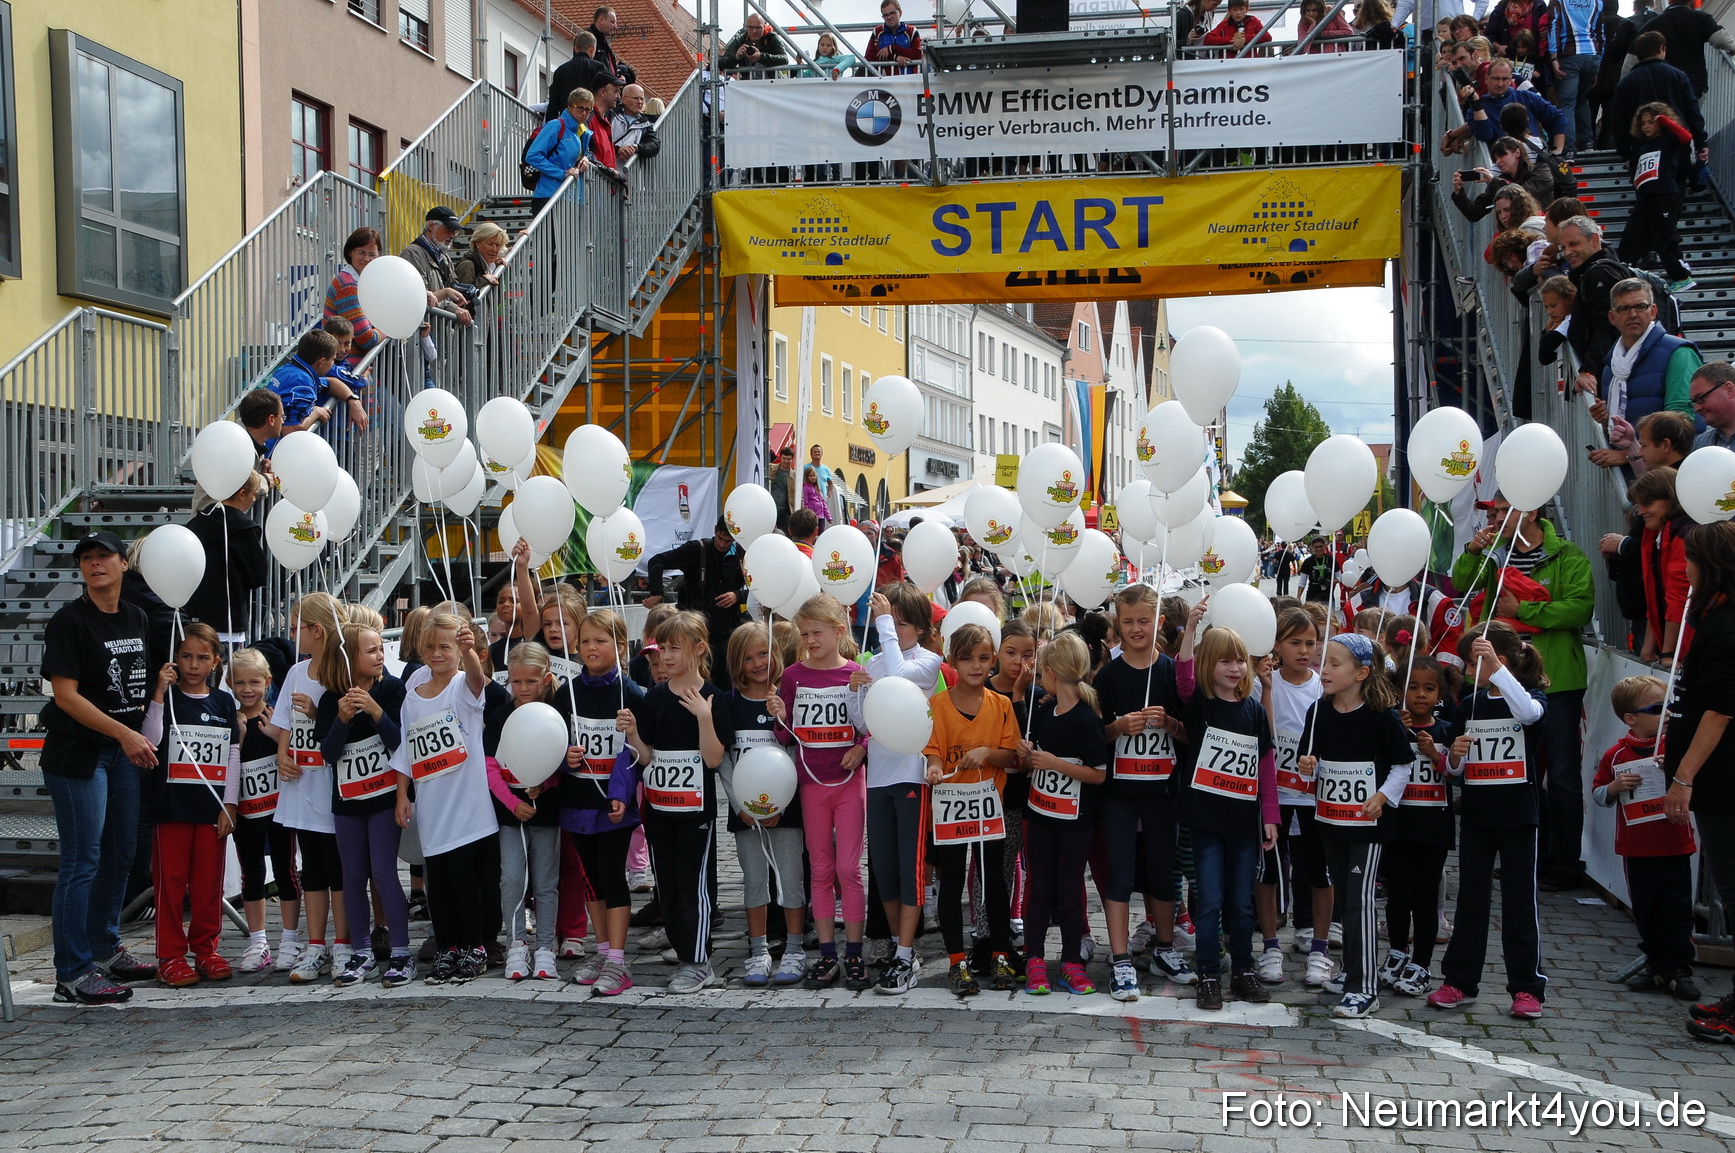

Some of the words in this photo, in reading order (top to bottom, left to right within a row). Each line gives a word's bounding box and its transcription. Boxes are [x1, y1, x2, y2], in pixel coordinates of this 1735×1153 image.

[851, 90, 898, 110] BMW
[916, 91, 993, 117] BMW
[1001, 80, 1270, 113] EfficientDynamics
[917, 117, 995, 140] Weniger
[999, 116, 1101, 136] Verbrauch.
[1106, 114, 1156, 132] Mehr
[1161, 111, 1272, 130] Fahrfreude.
[930, 195, 1165, 257] START
[1207, 220, 1291, 235] Neumarkter
[1293, 218, 1360, 232] Stadtlauf
[748, 235, 827, 248] Neumarkter
[829, 233, 892, 247] Stadtlauf
[996, 463, 1019, 471] Jugend-
[1105, 512, 1114, 524] A
[798, 702, 848, 726] 7209
[416, 719, 444, 735] Neumarkt
[195, 731, 222, 740] Neumarkt
[409, 726, 455, 760] 7036
[806, 730, 843, 741] Theresa
[1206, 733, 1230, 746] PARTL
[356, 740, 384, 754] Neumark
[1122, 733, 1170, 756] 7024
[176, 741, 222, 764] 7331
[246, 762, 274, 774] Neumarkt
[342, 747, 392, 780] 7021
[423, 758, 448, 773] Mona
[1134, 762, 1160, 772] Lucia
[1208, 746, 1257, 778] 7258
[1472, 766, 1506, 777] Leonie
[362, 778, 386, 793] Lena
[1212, 776, 1248, 792] Carolin
[248, 797, 278, 812] Sophia
[654, 793, 685, 805] Tamina
[1034, 794, 1056, 810] Mona
[940, 796, 995, 822] 7250
[1326, 807, 1354, 818] Emma
[956, 824, 981, 836] Alicia
